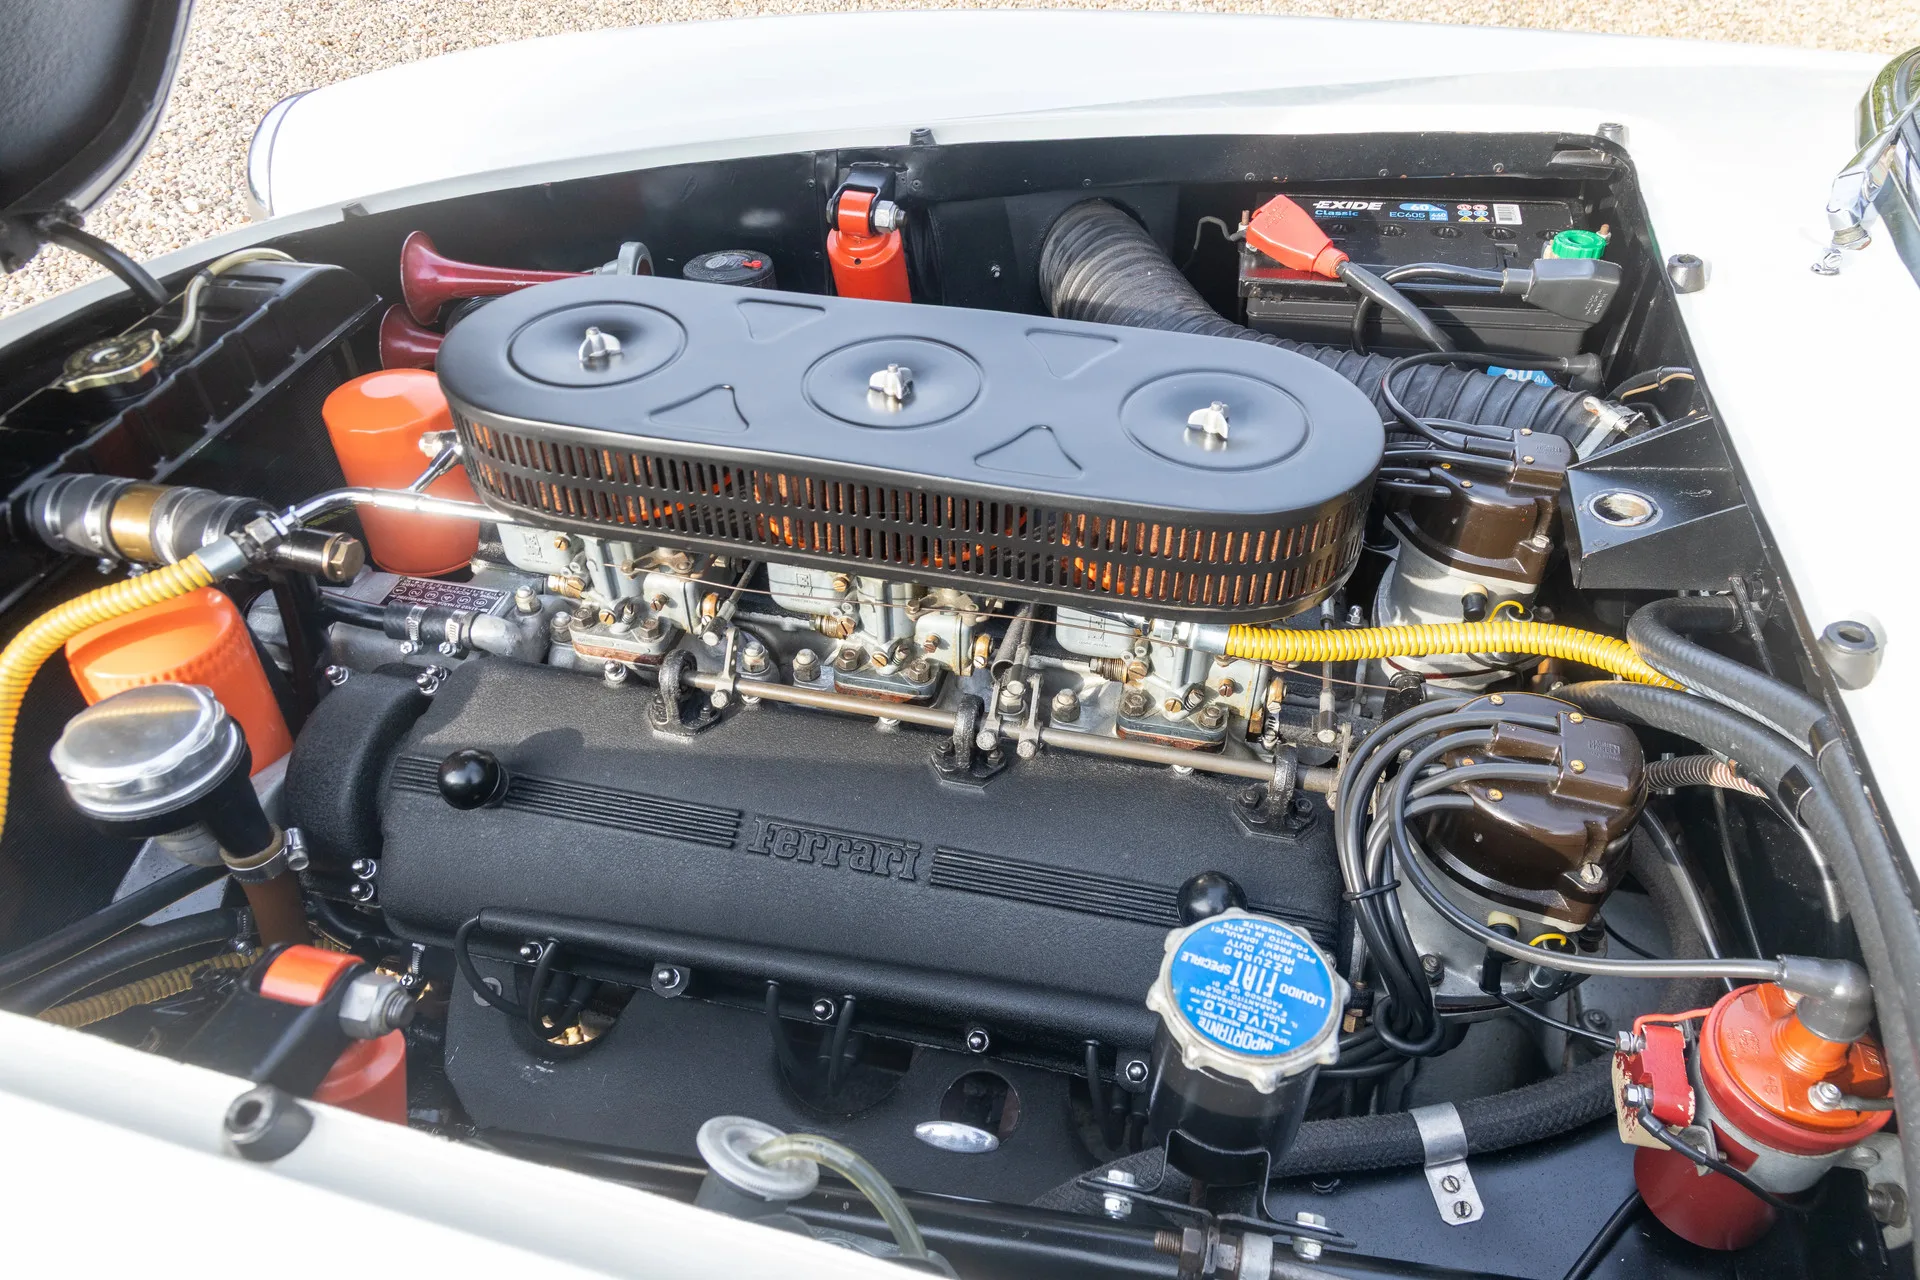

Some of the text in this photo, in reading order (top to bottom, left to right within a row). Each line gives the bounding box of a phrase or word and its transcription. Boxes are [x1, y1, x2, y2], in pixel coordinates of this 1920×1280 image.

[1313, 200, 1383, 210] EXIDE
[747, 815, 921, 881] Ferrari
[1223, 921, 1309, 953] FORNITO IN LATTE
[1242, 920, 1293, 940] PIOMBATE
[1211, 925, 1317, 964] PER FRENI IDRAULICI
[1225, 939, 1295, 965] HEAVY DUTY
[1222, 947, 1293, 975] AZZURRO
[1180, 951, 1326, 1008] LIQUIDO FIAT SPECIALE
[1205, 985, 1227, 998] SOLO
[1189, 986, 1259, 1015] FUNZIONAMENTO
[1212, 980, 1283, 1009] FACENDO USO DI
[1230, 995, 1278, 1013] GARANTITO
[1263, 1011, 1287, 1023] BUON
[1197, 1017, 1273, 1051] IMPORTANTE
